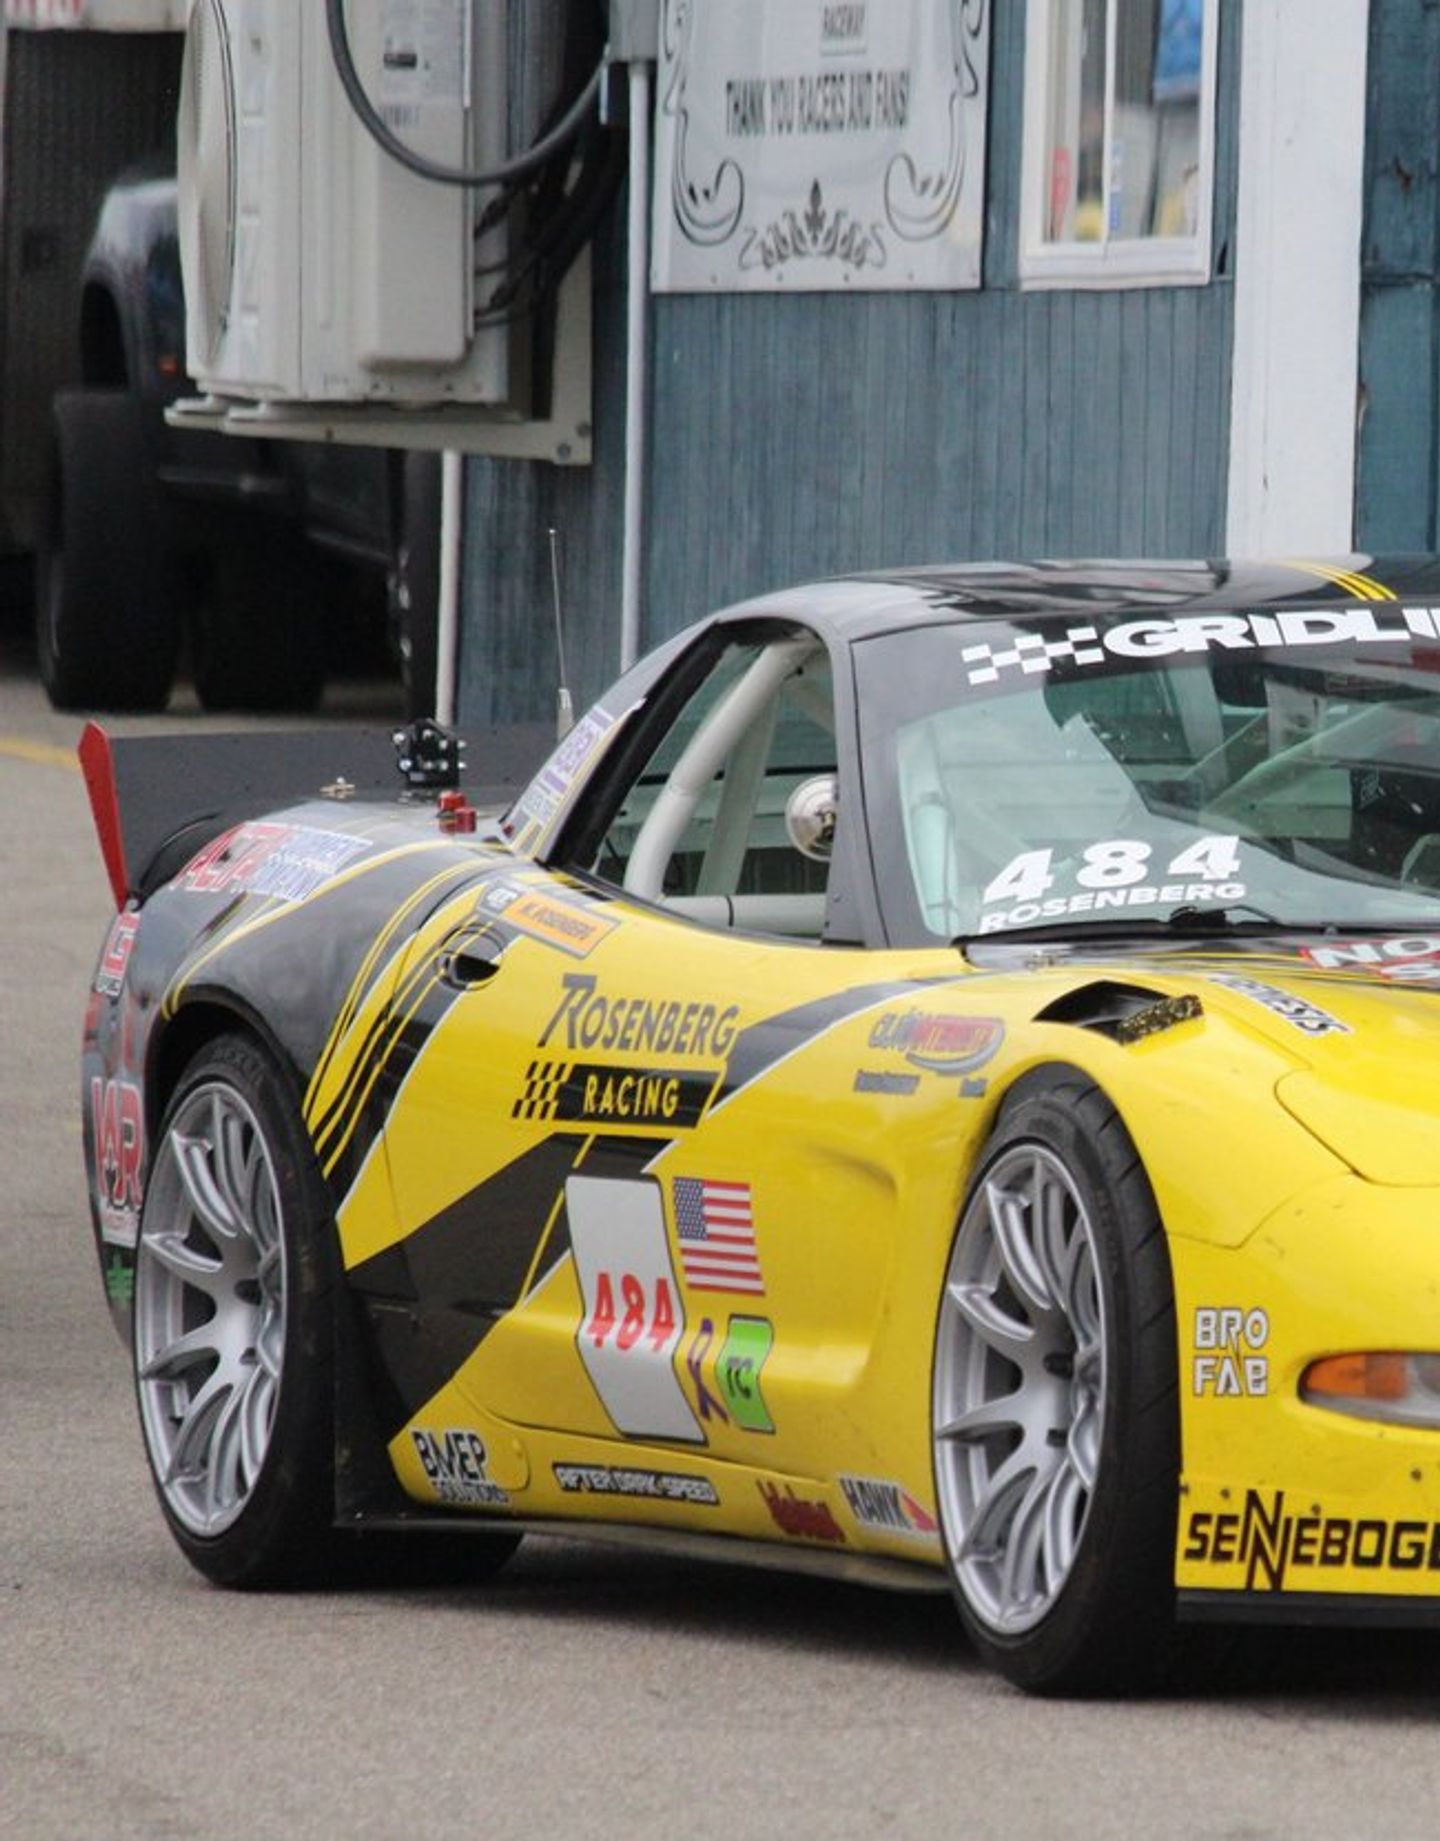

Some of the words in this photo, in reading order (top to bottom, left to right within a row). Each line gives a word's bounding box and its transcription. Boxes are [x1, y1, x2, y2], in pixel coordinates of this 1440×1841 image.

[726, 78, 766, 138] THANK
[769, 76, 797, 136] YOU
[798, 72, 846, 134] RACERS
[849, 70, 874, 131] AND
[978, 882, 1248, 935] ROSENBERG
[536, 972, 742, 1058] ROSENBERG
[582, 1074, 681, 1118] RACING
[586, 1271, 675, 1353] 484
[1194, 1307, 1270, 1350] BRO
[1193, 1355, 1269, 1398] FAB
[839, 1477, 913, 1531] HAWK
